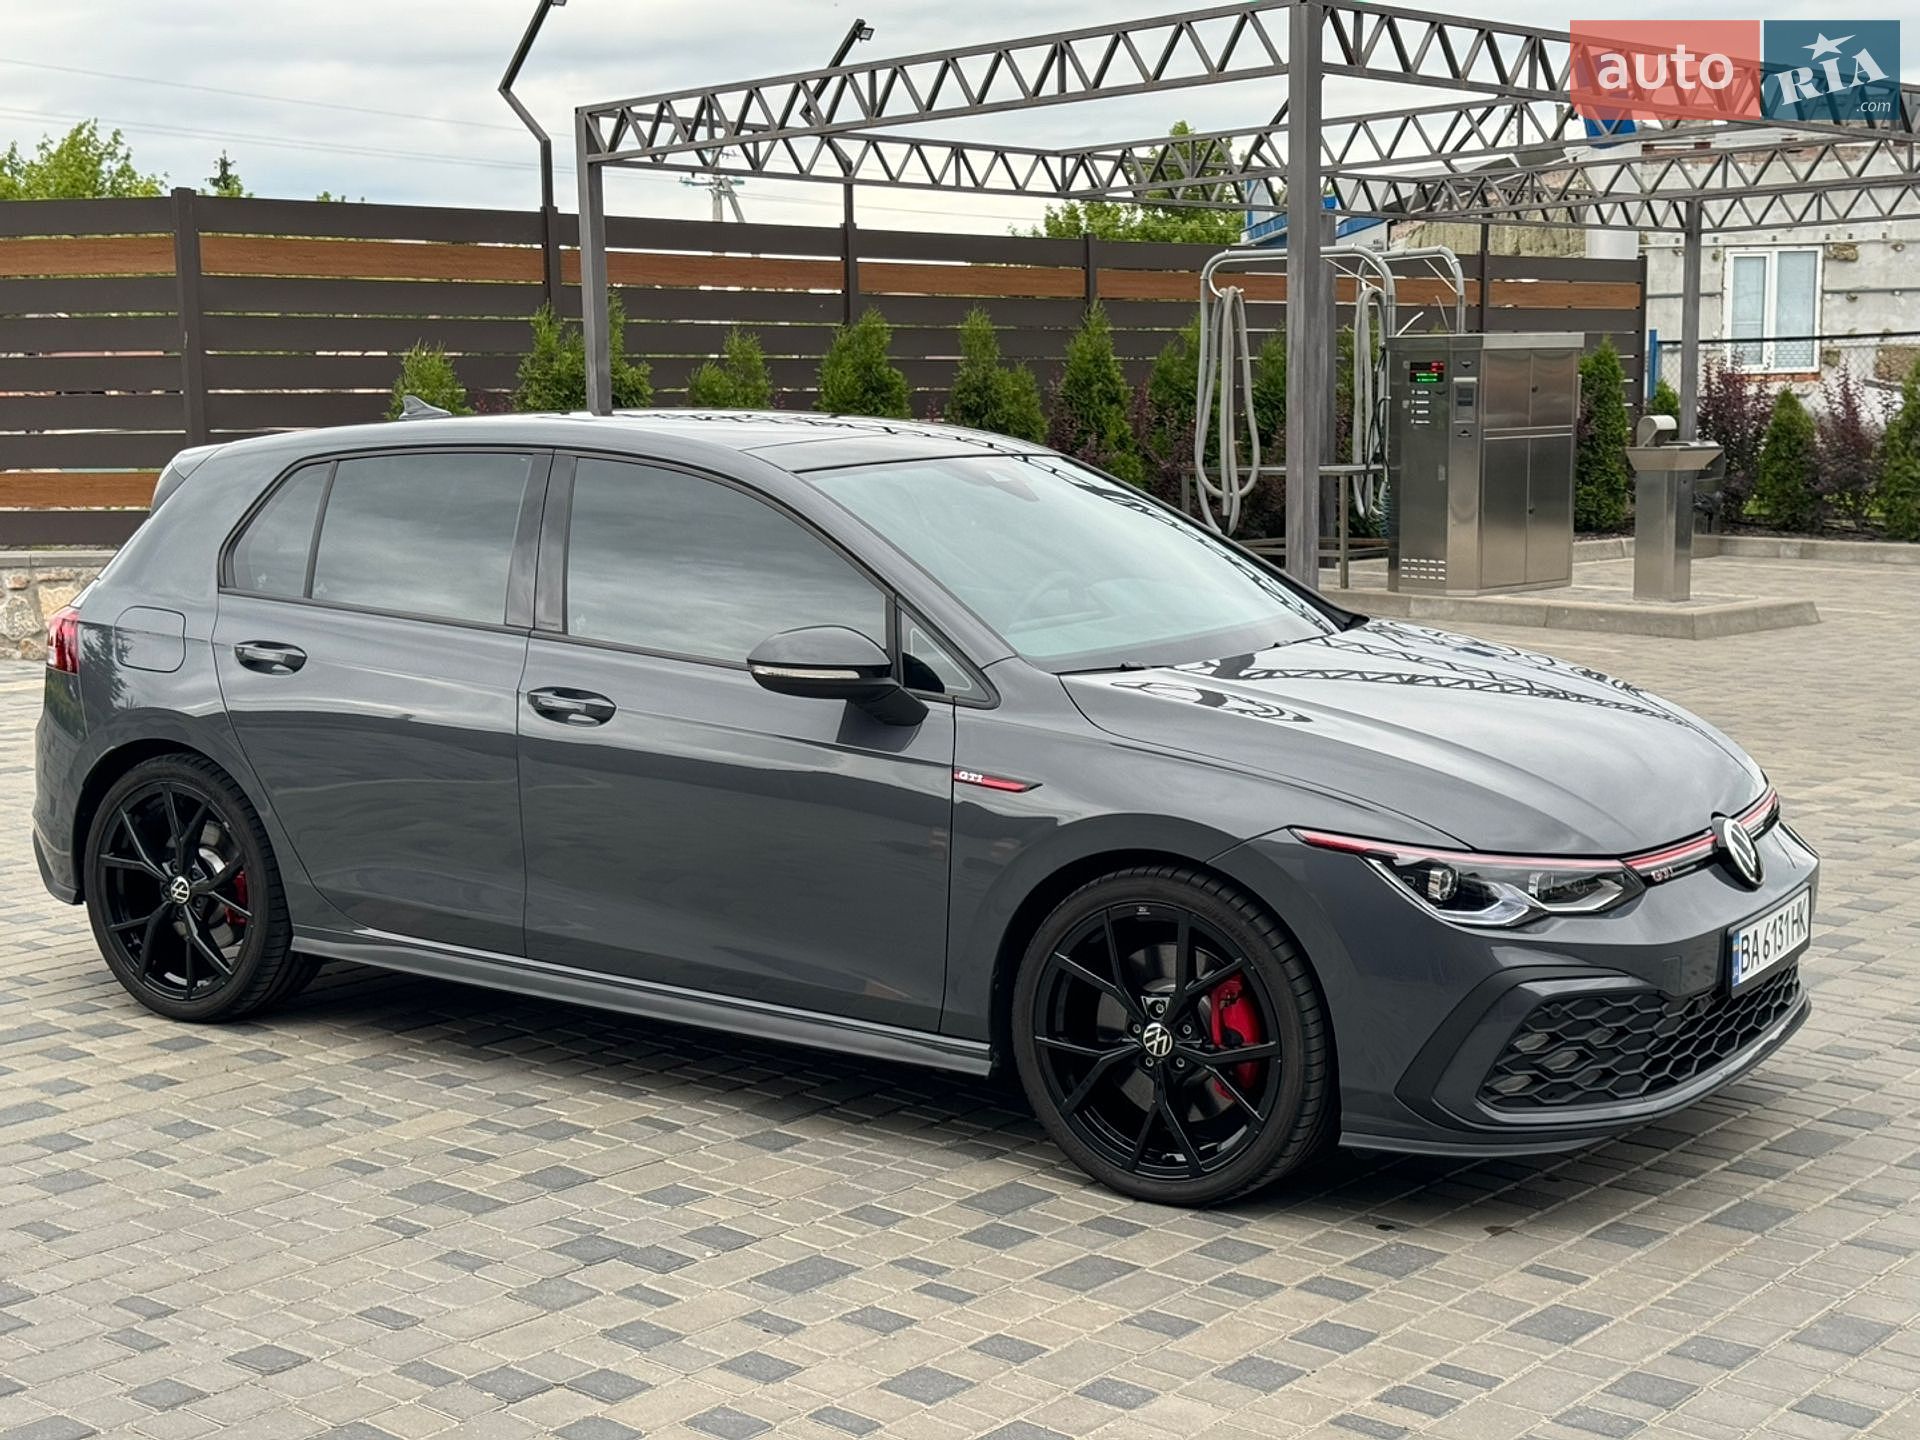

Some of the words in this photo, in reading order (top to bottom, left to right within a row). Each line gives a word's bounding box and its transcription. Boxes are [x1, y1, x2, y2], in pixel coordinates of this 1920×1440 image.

[958, 770, 984, 783] GTI
[1741, 929, 1760, 974] BA
[1763, 910, 1789, 960] 6131
[1791, 897, 1807, 942] HK
